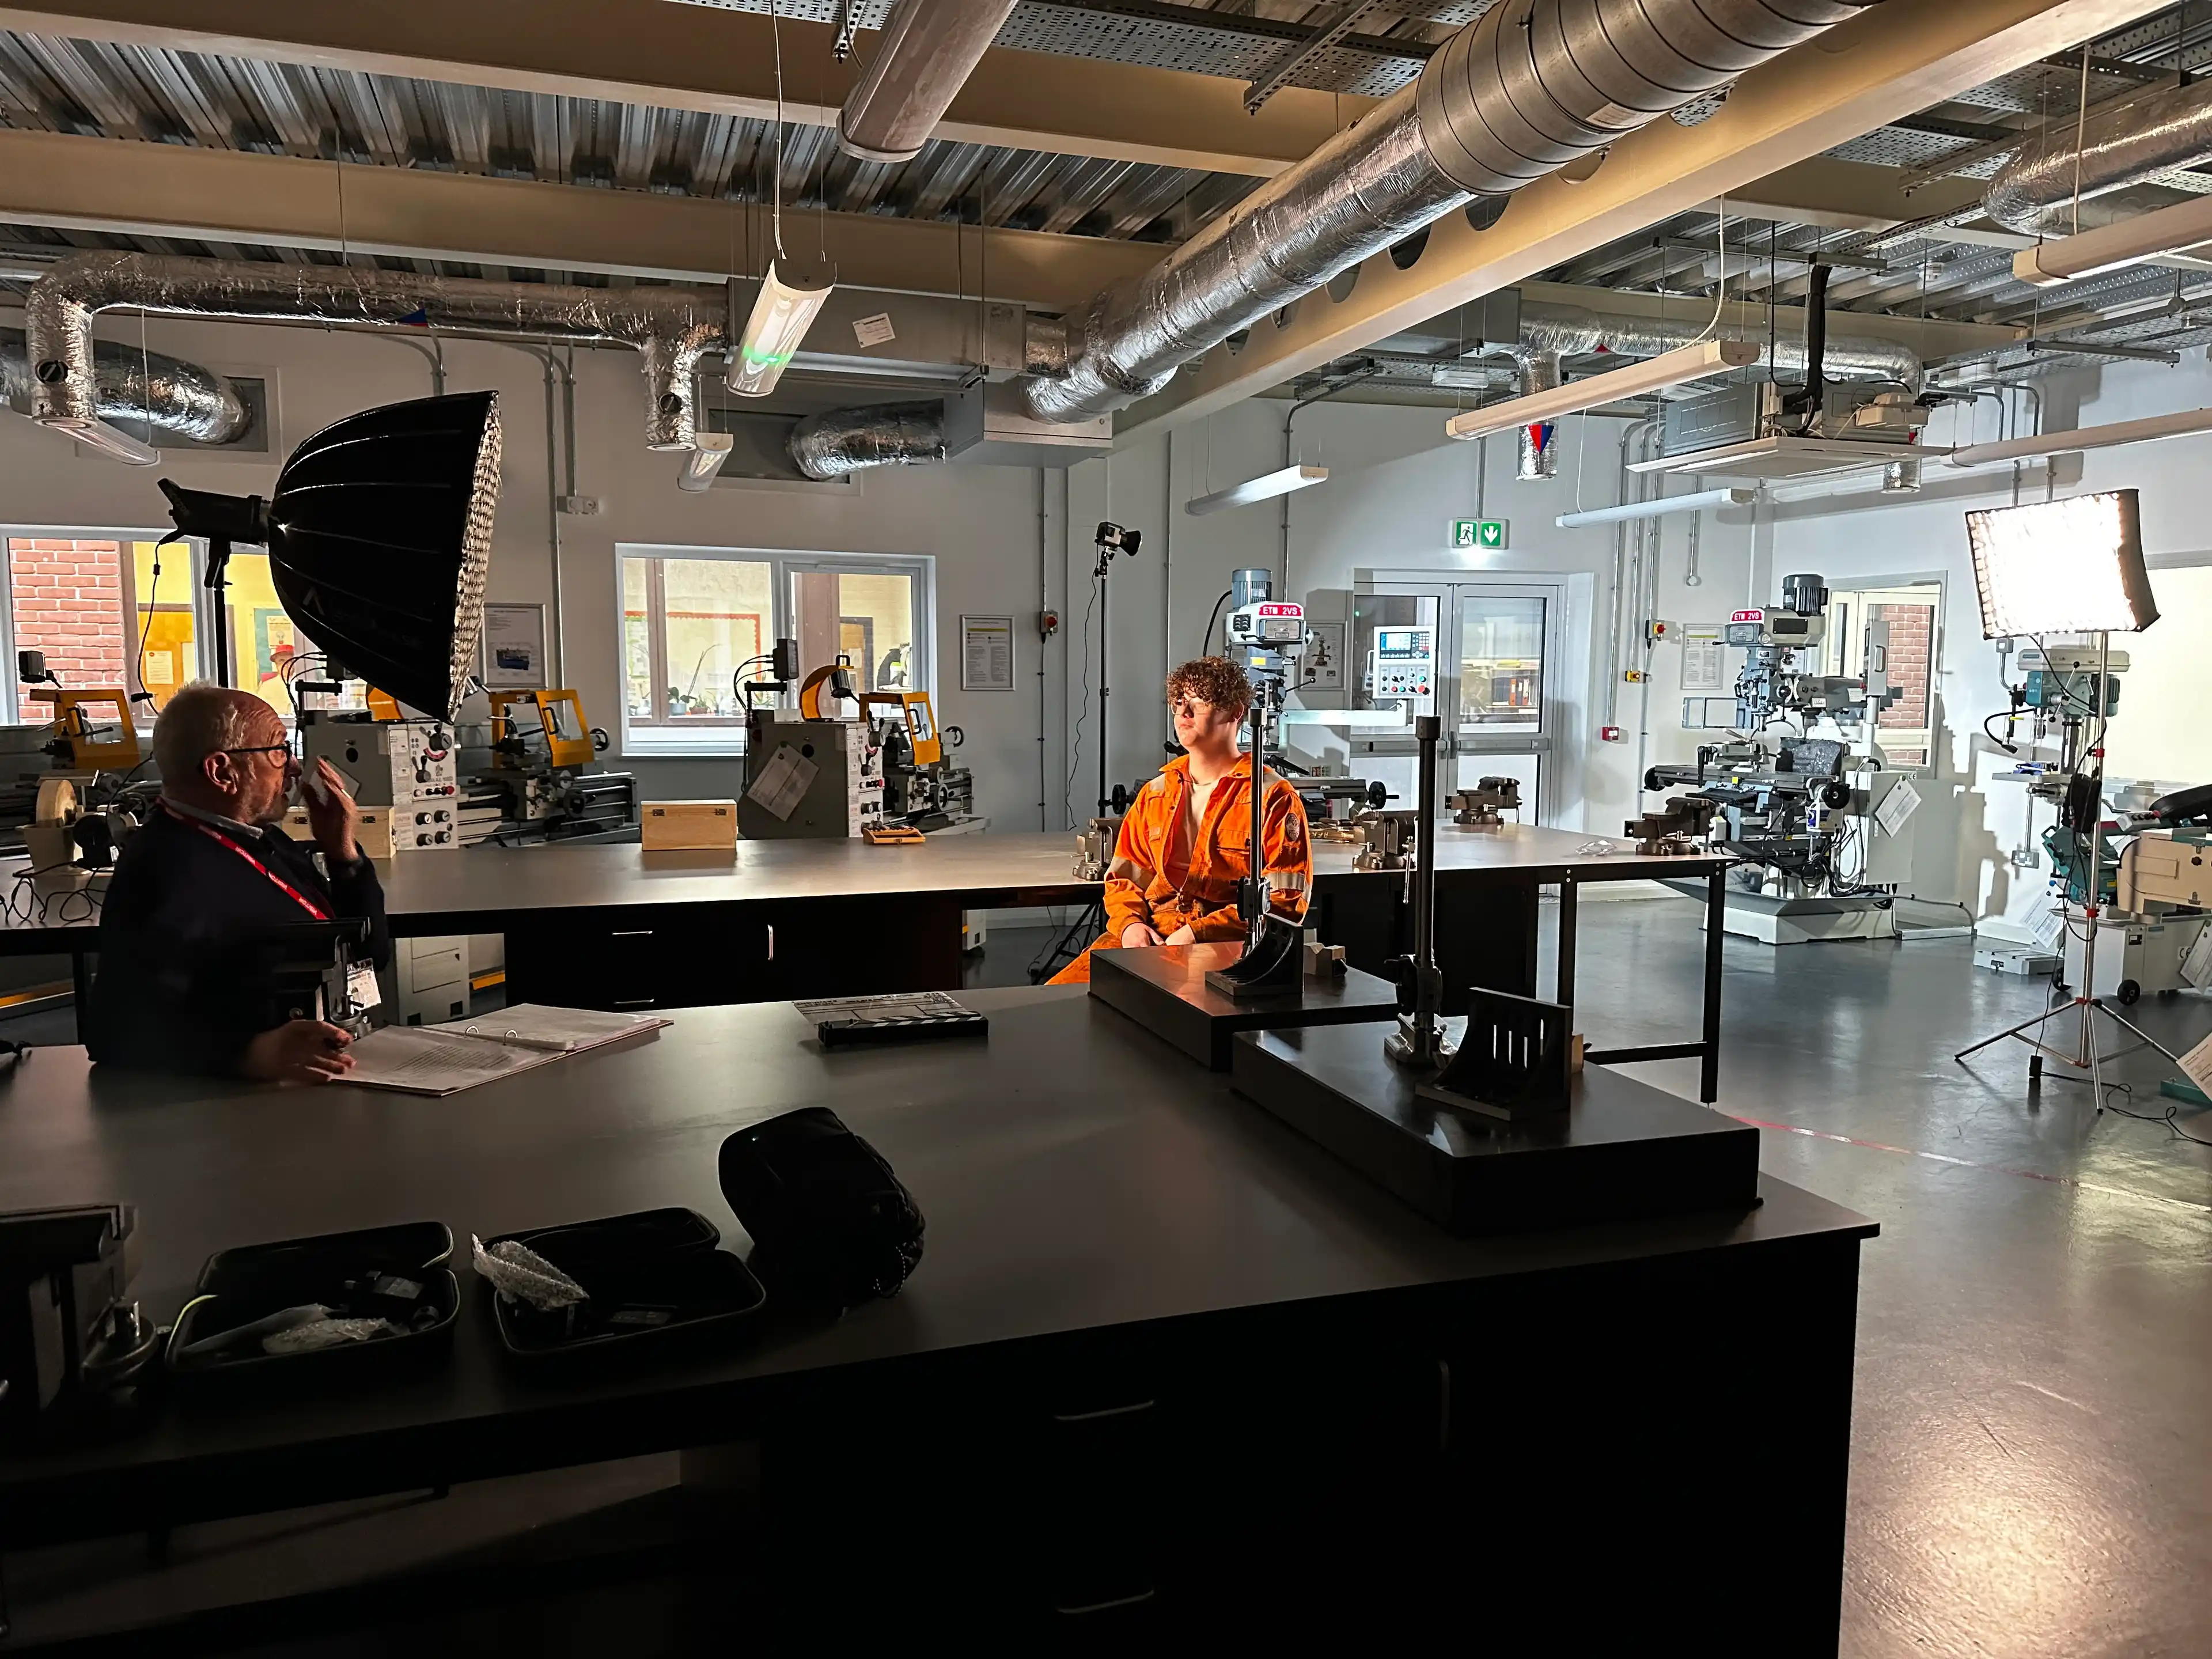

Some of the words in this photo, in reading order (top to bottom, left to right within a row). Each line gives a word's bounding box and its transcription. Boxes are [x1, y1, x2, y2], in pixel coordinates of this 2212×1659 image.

[1282, 607, 1297, 615] 2VS
[1748, 612, 1759, 620] 2VS
[298, 896, 318, 915] VISITOR
